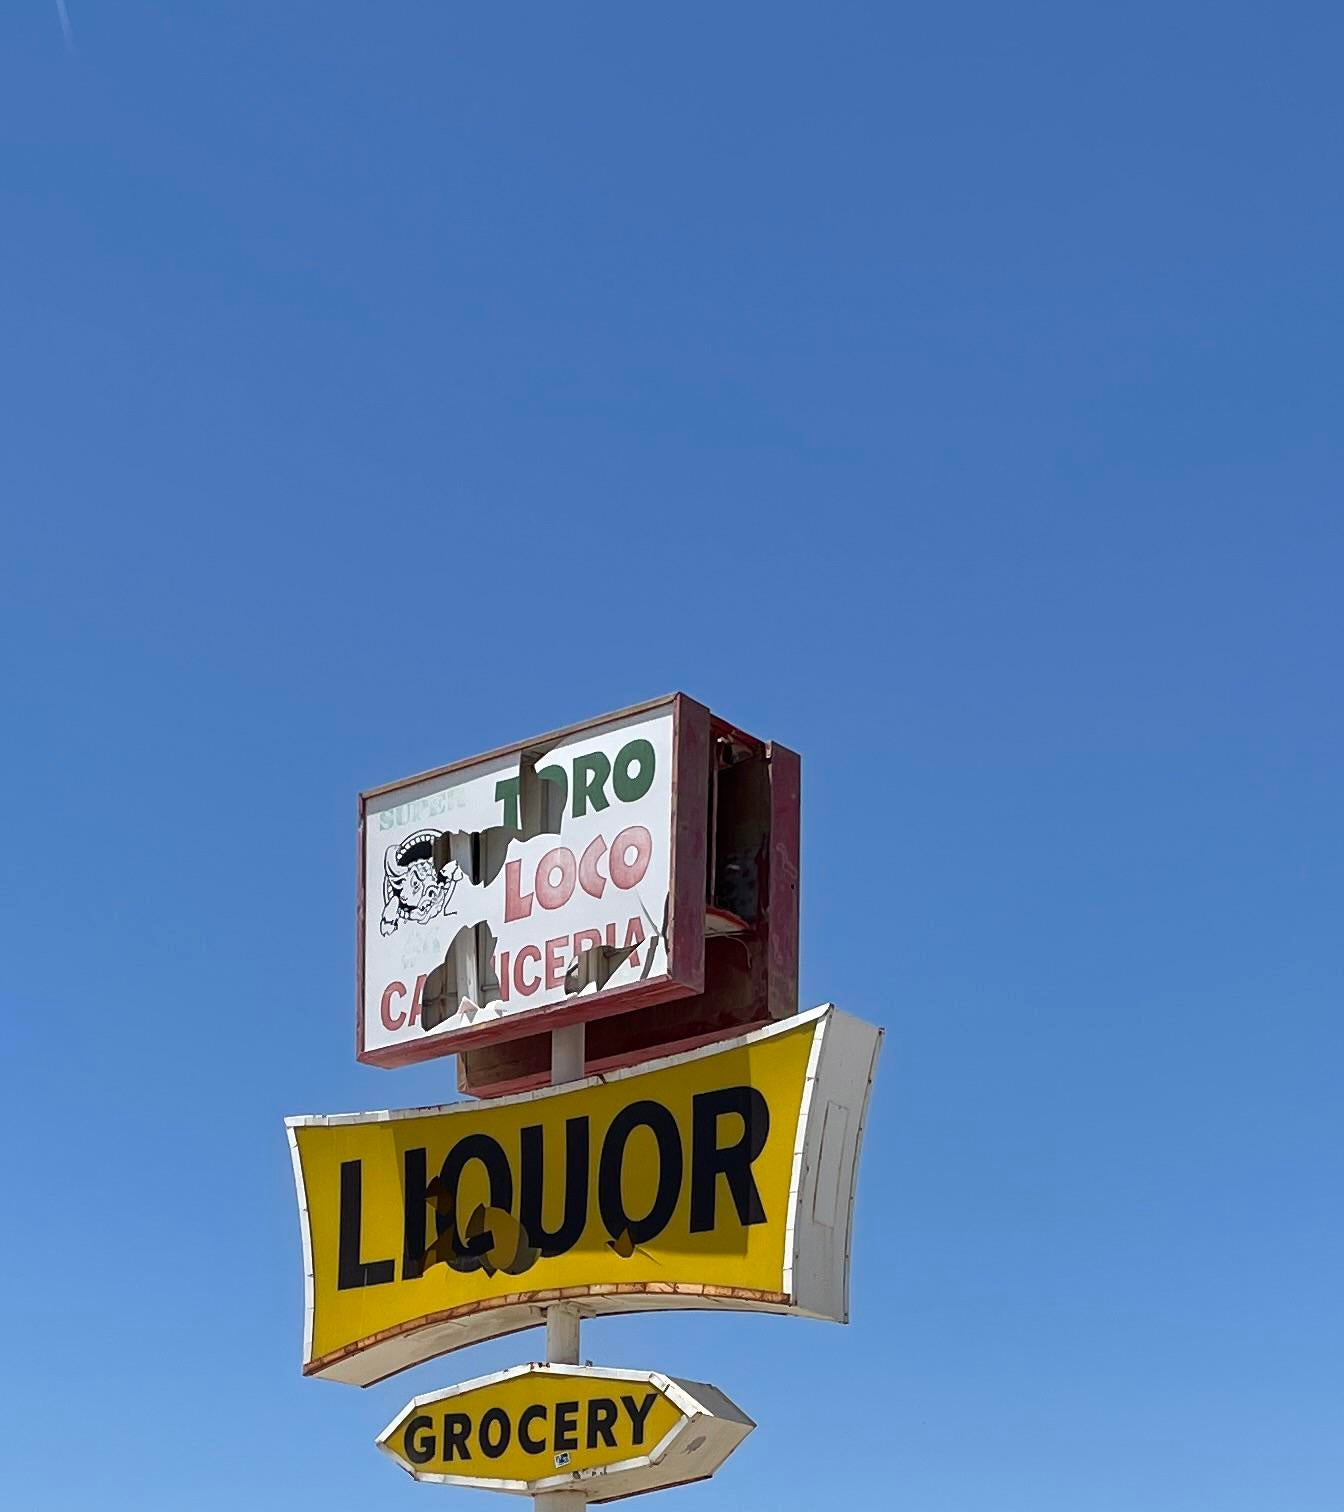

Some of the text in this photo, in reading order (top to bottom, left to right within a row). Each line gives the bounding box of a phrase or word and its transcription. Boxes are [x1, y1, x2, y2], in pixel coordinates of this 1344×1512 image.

[503, 825, 653, 923] LOCO
[380, 915, 647, 1032] CAICERIA
[337, 1085, 770, 1290] LIQUOR
[403, 1393, 657, 1464] GROCERY
